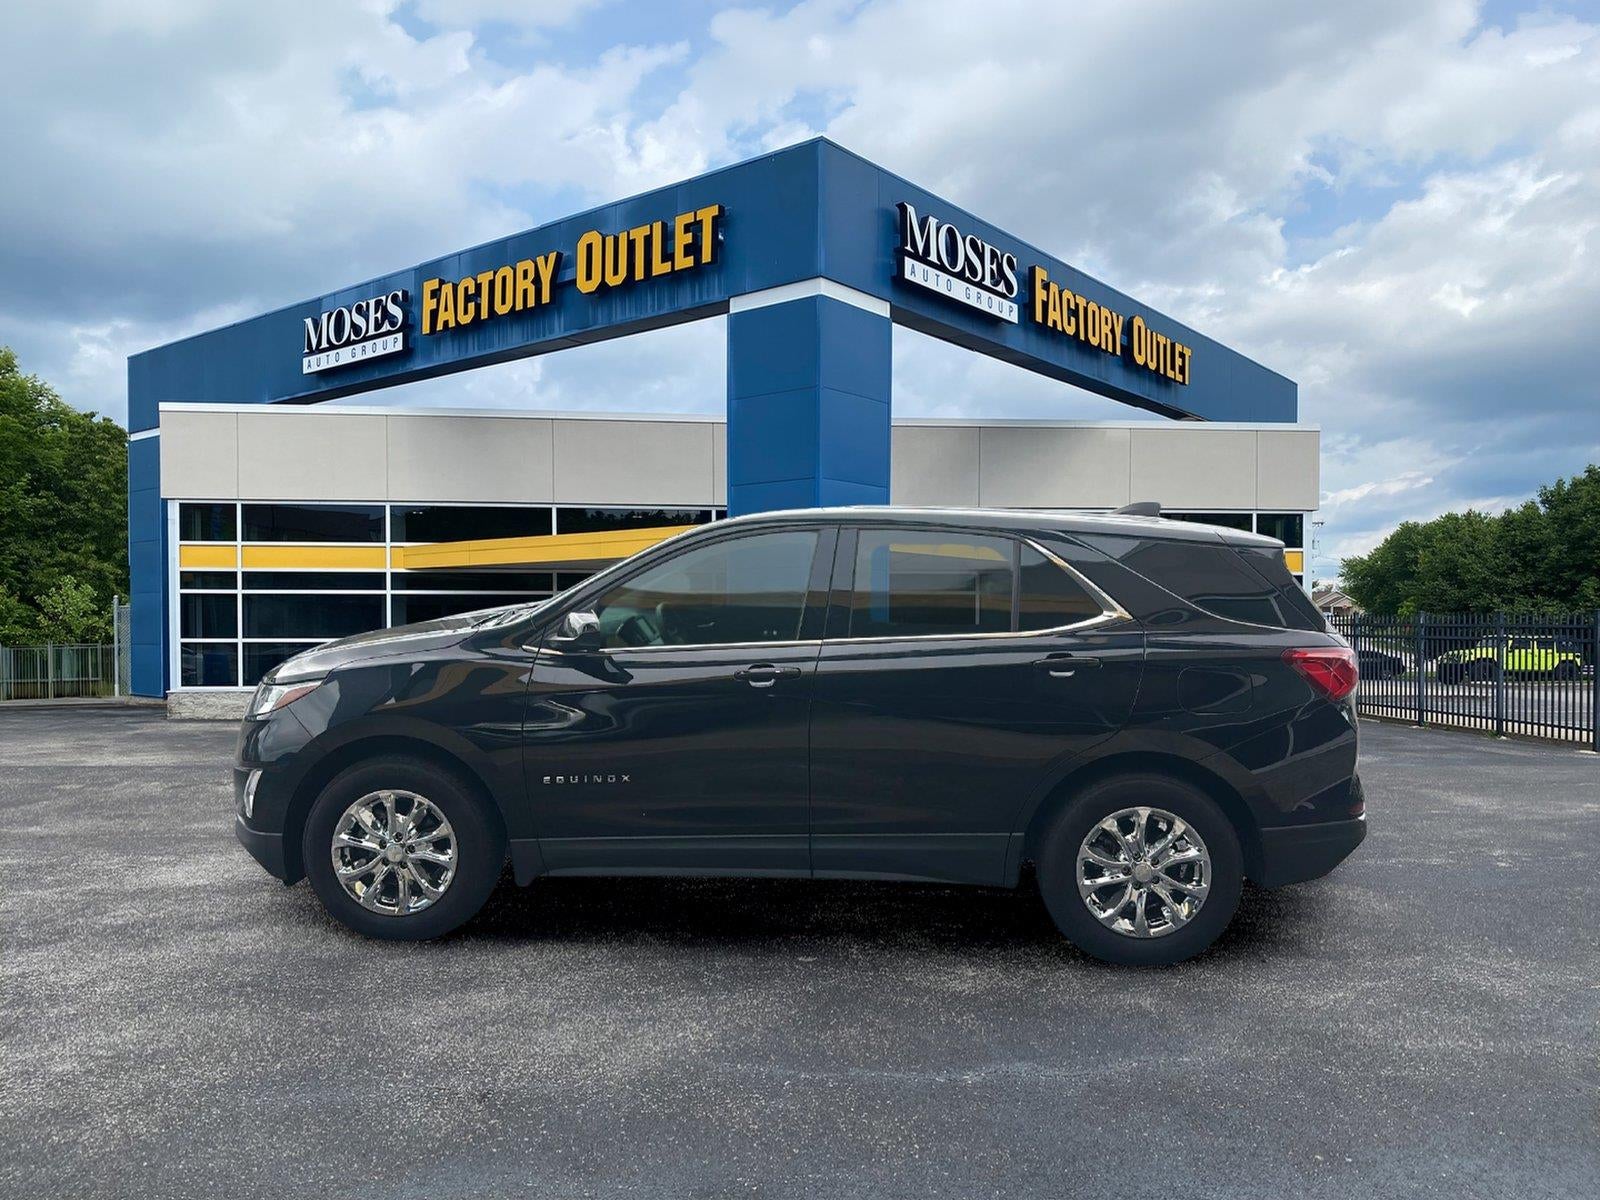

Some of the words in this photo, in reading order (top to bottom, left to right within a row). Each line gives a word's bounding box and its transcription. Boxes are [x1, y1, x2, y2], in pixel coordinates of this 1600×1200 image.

[422, 251, 560, 336] FACTORY
[576, 204, 721, 295] OUTLET
[904, 202, 1019, 299] MOSES
[302, 290, 404, 355] MOSES
[909, 263, 953, 292] AUTO
[964, 286, 1015, 317] GROUP
[306, 351, 341, 371] AUTO
[350, 336, 400, 360] GROUP
[1034, 265, 1125, 357] FACTORY
[1132, 315, 1192, 386] OUTLET
[543, 775, 631, 785] EQUINOX
